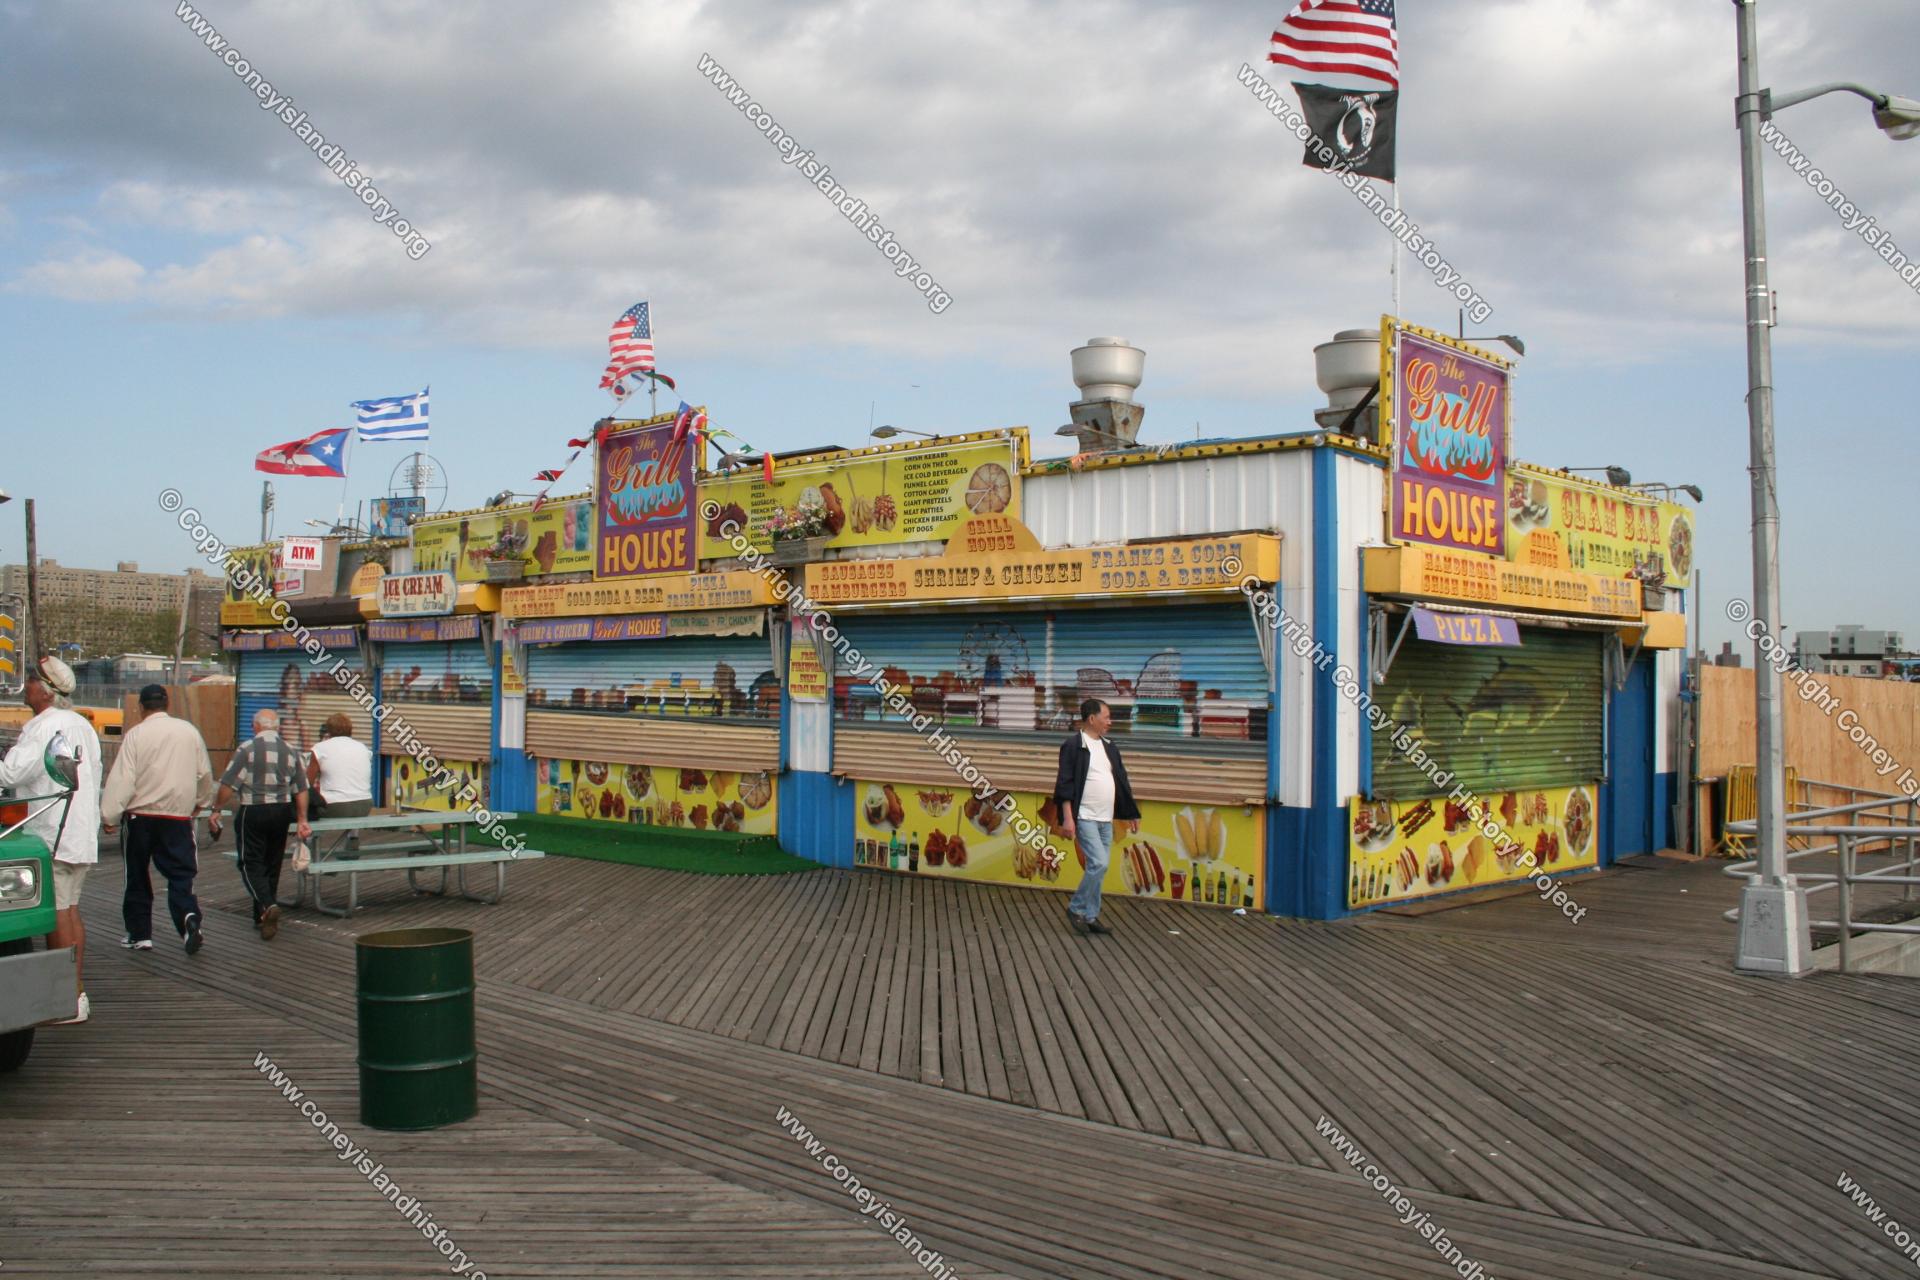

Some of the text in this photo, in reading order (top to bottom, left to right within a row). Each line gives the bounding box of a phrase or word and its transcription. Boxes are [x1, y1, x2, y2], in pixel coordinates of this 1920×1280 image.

[1440, 354, 1466, 381] The
[1406, 358, 1497, 439] Grill
[635, 433, 656, 451] The
[608, 440, 685, 493] Grill
[915, 471, 931, 479] COLD
[933, 467, 968, 477] BEVERAGES
[933, 461, 944, 470] THE
[945, 459, 958, 467] COB
[904, 479, 948, 489] FUNNEL CAKES
[904, 488, 949, 498] COTTON CANDY
[903, 506, 944, 516] MEAT PATTIES
[904, 497, 952, 507] GIANT PRETZELS
[903, 514, 958, 525] CHICKEN BREASTS
[1403, 480, 1498, 548] HOUSE
[1561, 489, 1661, 545] CLAM BAR
[967, 518, 1012, 535] GRILL
[291, 545, 315, 560] ATM
[604, 528, 687, 573] HOUSE
[967, 535, 1016, 552] HOUSE
[1091, 543, 1242, 568] FRANKS & CORN
[1530, 550, 1559, 568] HOUSE
[1589, 543, 1613, 564] BEER
[821, 563, 894, 581] SAUSAGES
[914, 562, 1083, 588] SHRIMP & CHICKEN
[1424, 552, 1496, 581] HAMBURGER
[383, 575, 444, 599] ICE CREAM
[690, 575, 728, 591] PIZZA
[1101, 567, 1231, 589] SODA & BEER
[566, 588, 664, 607] COLD SODA & BEER
[810, 581, 907, 600] HAMBURGERS
[554, 623, 590, 639] CHICKEN
[594, 618, 662, 639] Grill HOUSE
[1434, 614, 1503, 643] PIZZA
